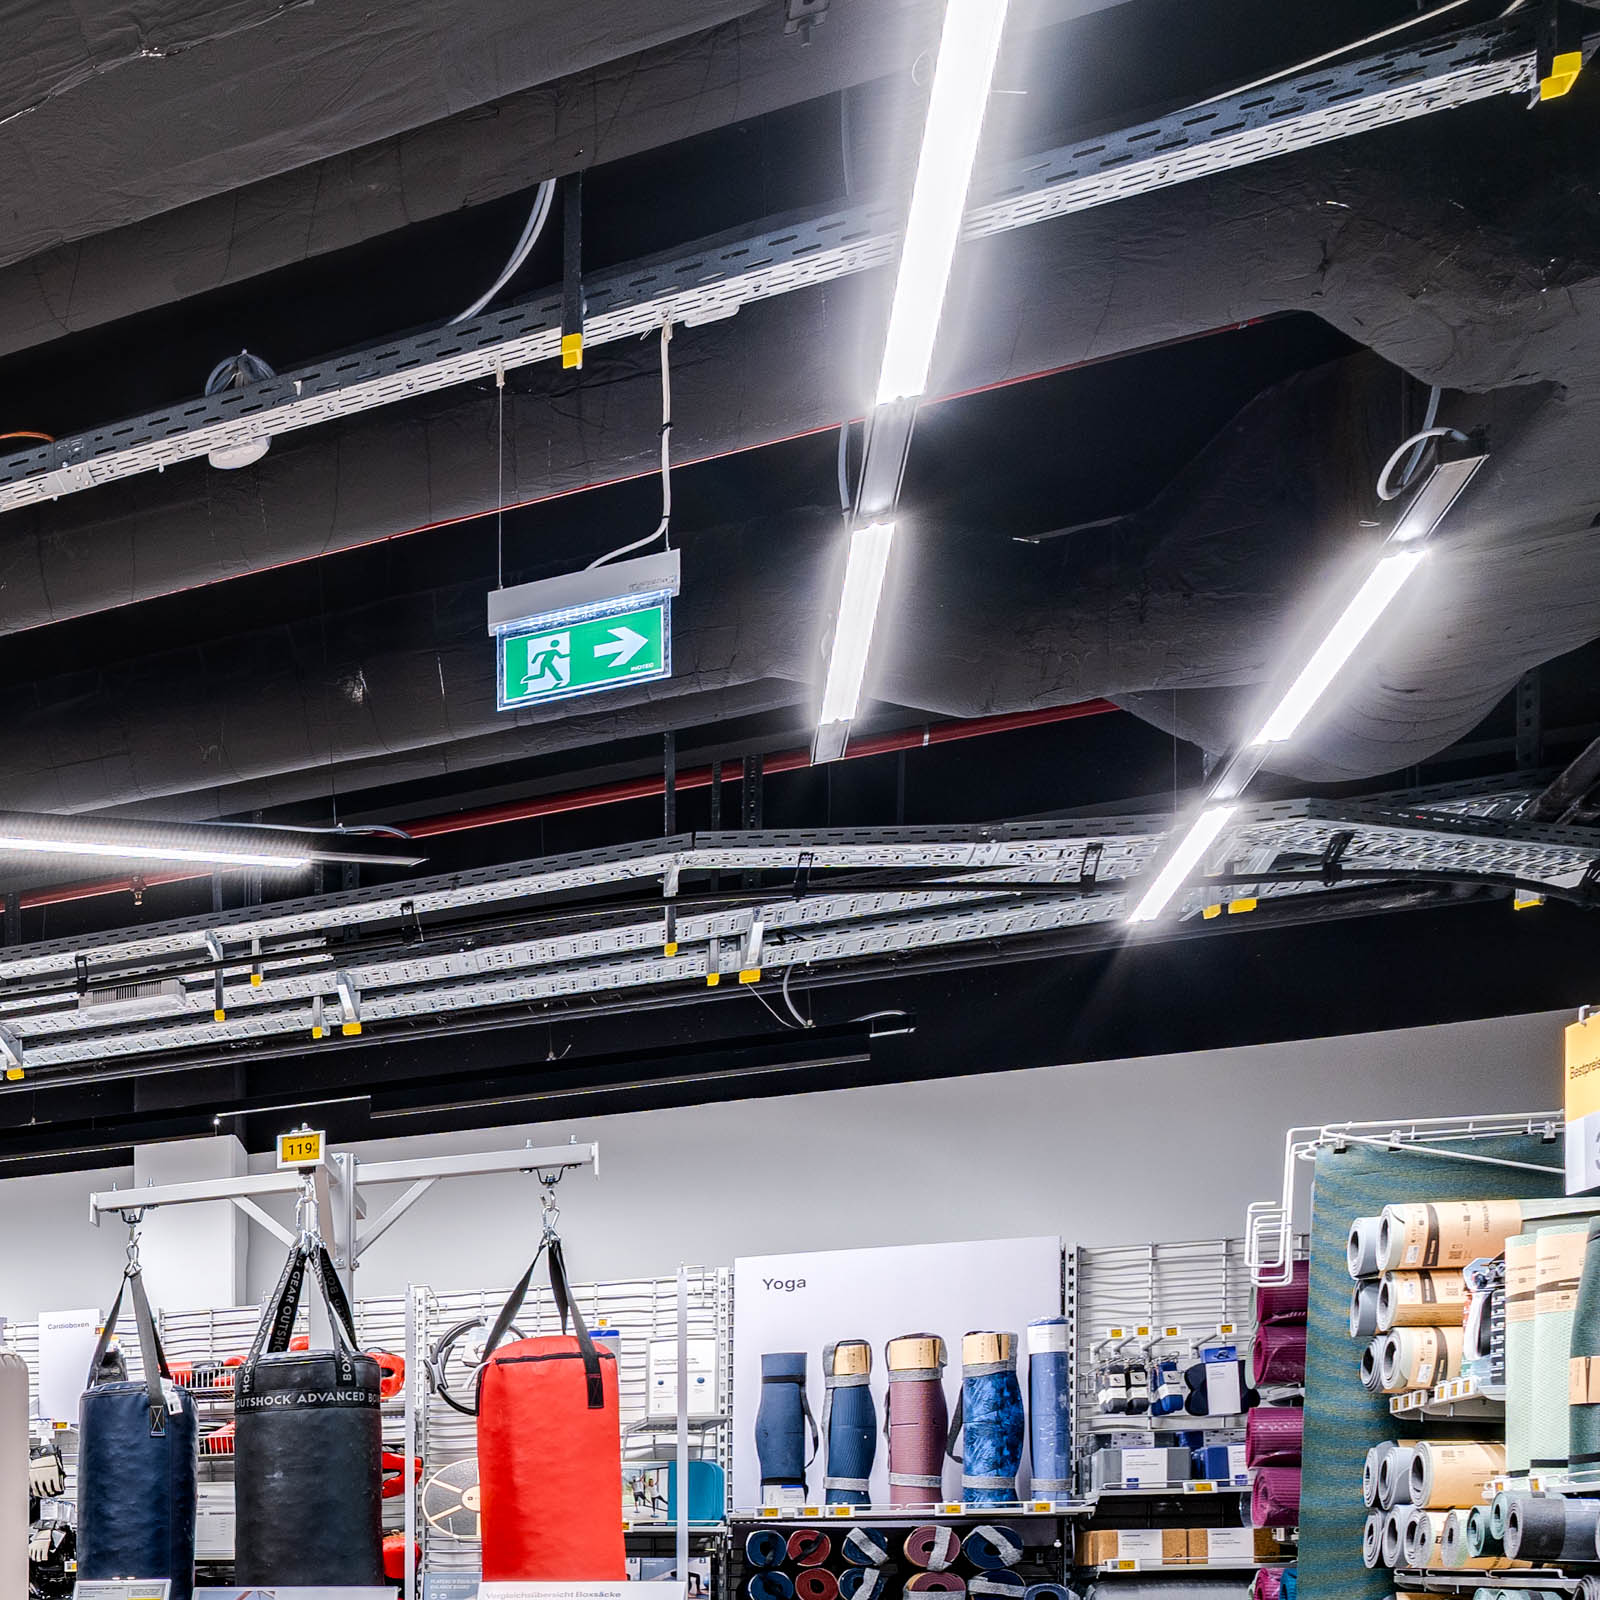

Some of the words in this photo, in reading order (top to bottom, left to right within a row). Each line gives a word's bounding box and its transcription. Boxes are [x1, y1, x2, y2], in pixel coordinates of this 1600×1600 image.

[288, 1142, 312, 1155] 119
[287, 1271, 301, 1304] GEAR
[762, 1278, 806, 1292] Yoga
[48, 1322, 90, 1330] Cardioboxen
[236, 1393, 291, 1409] OUTSHOCK
[297, 1391, 365, 1404] ADVANCED
[486, 1591, 574, 1600] Vergleichsübersicht
